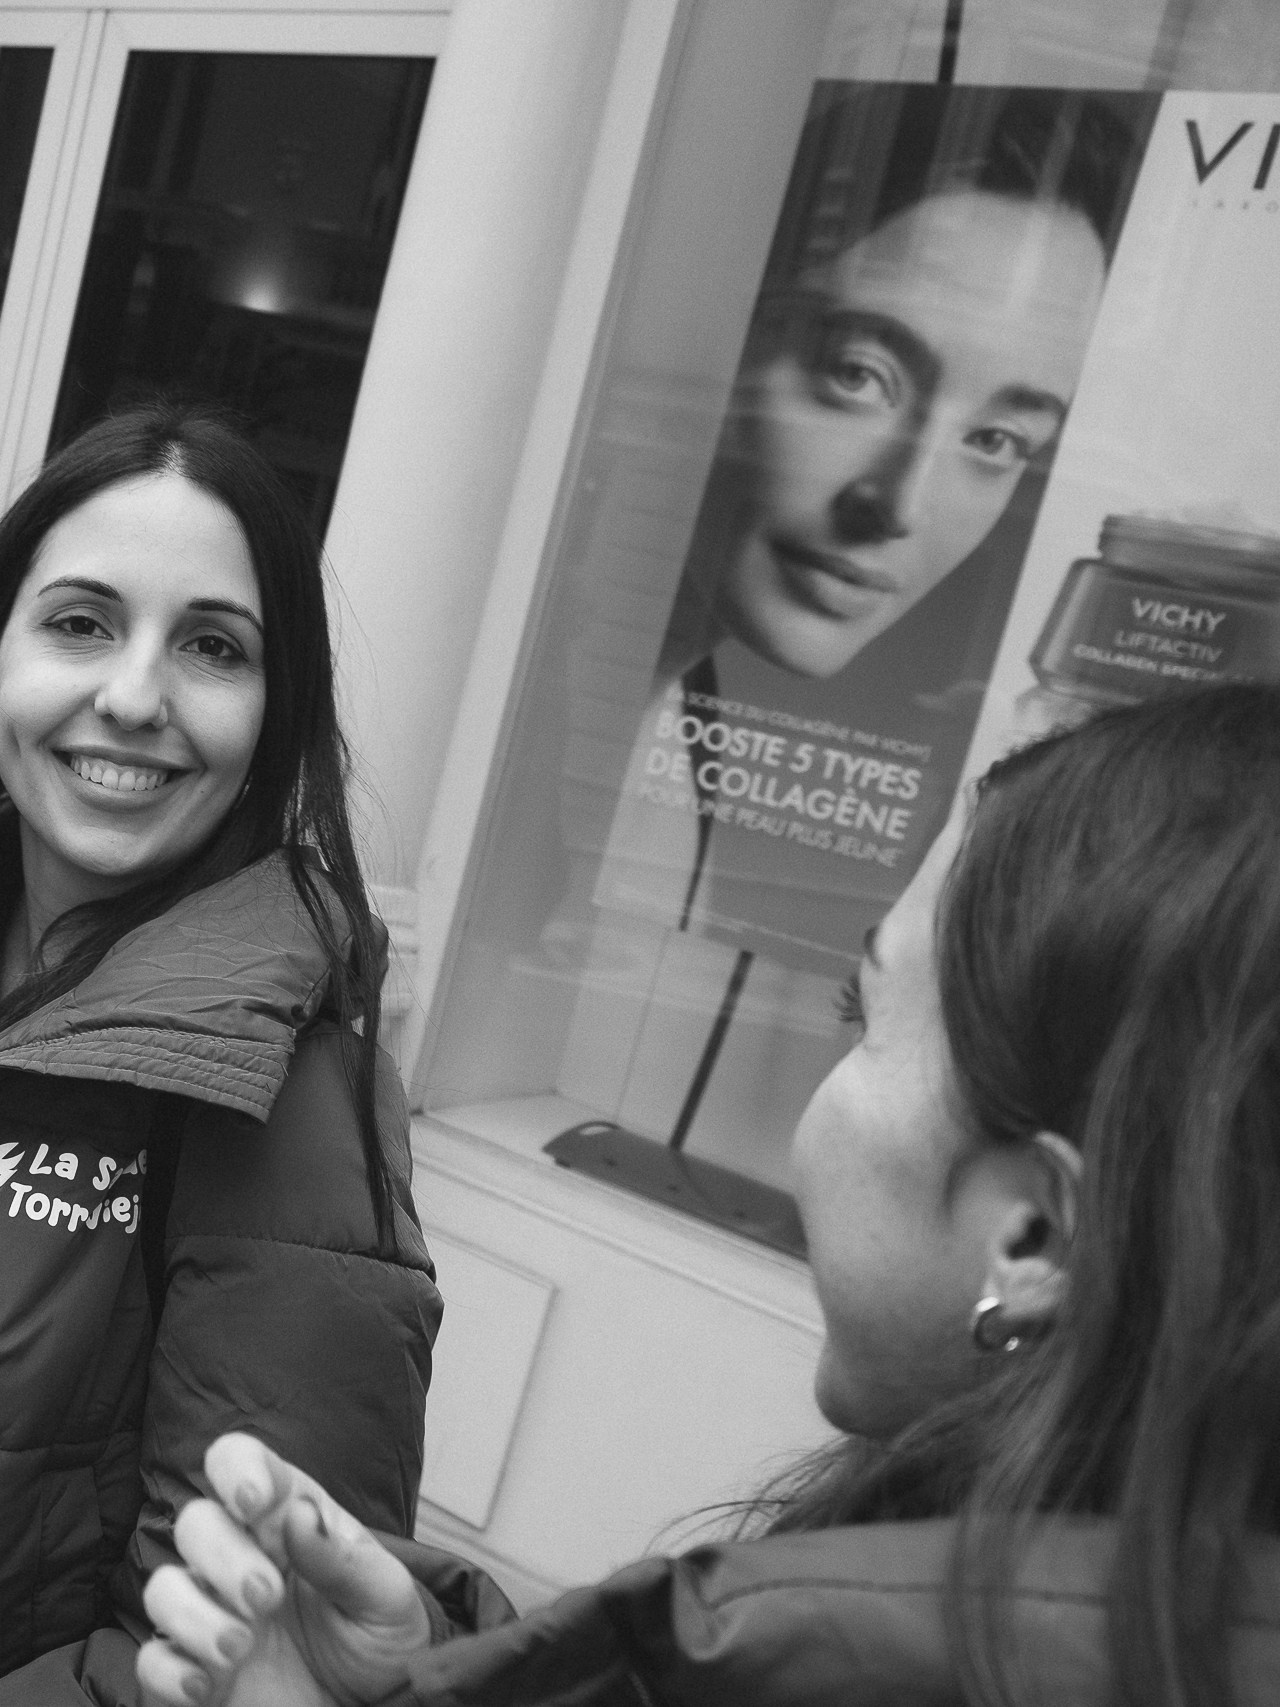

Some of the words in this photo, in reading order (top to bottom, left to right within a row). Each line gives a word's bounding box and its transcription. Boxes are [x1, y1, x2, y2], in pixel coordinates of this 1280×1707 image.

[1132, 596, 1227, 634] VICHY
[1114, 630, 1223, 663] LIFTACTIV
[646, 747, 690, 783] DE
[656, 711, 787, 767] BOOSTE
[789, 742, 816, 774] 5
[823, 748, 922, 800] TYPES
[29, 1143, 79, 1180] La
